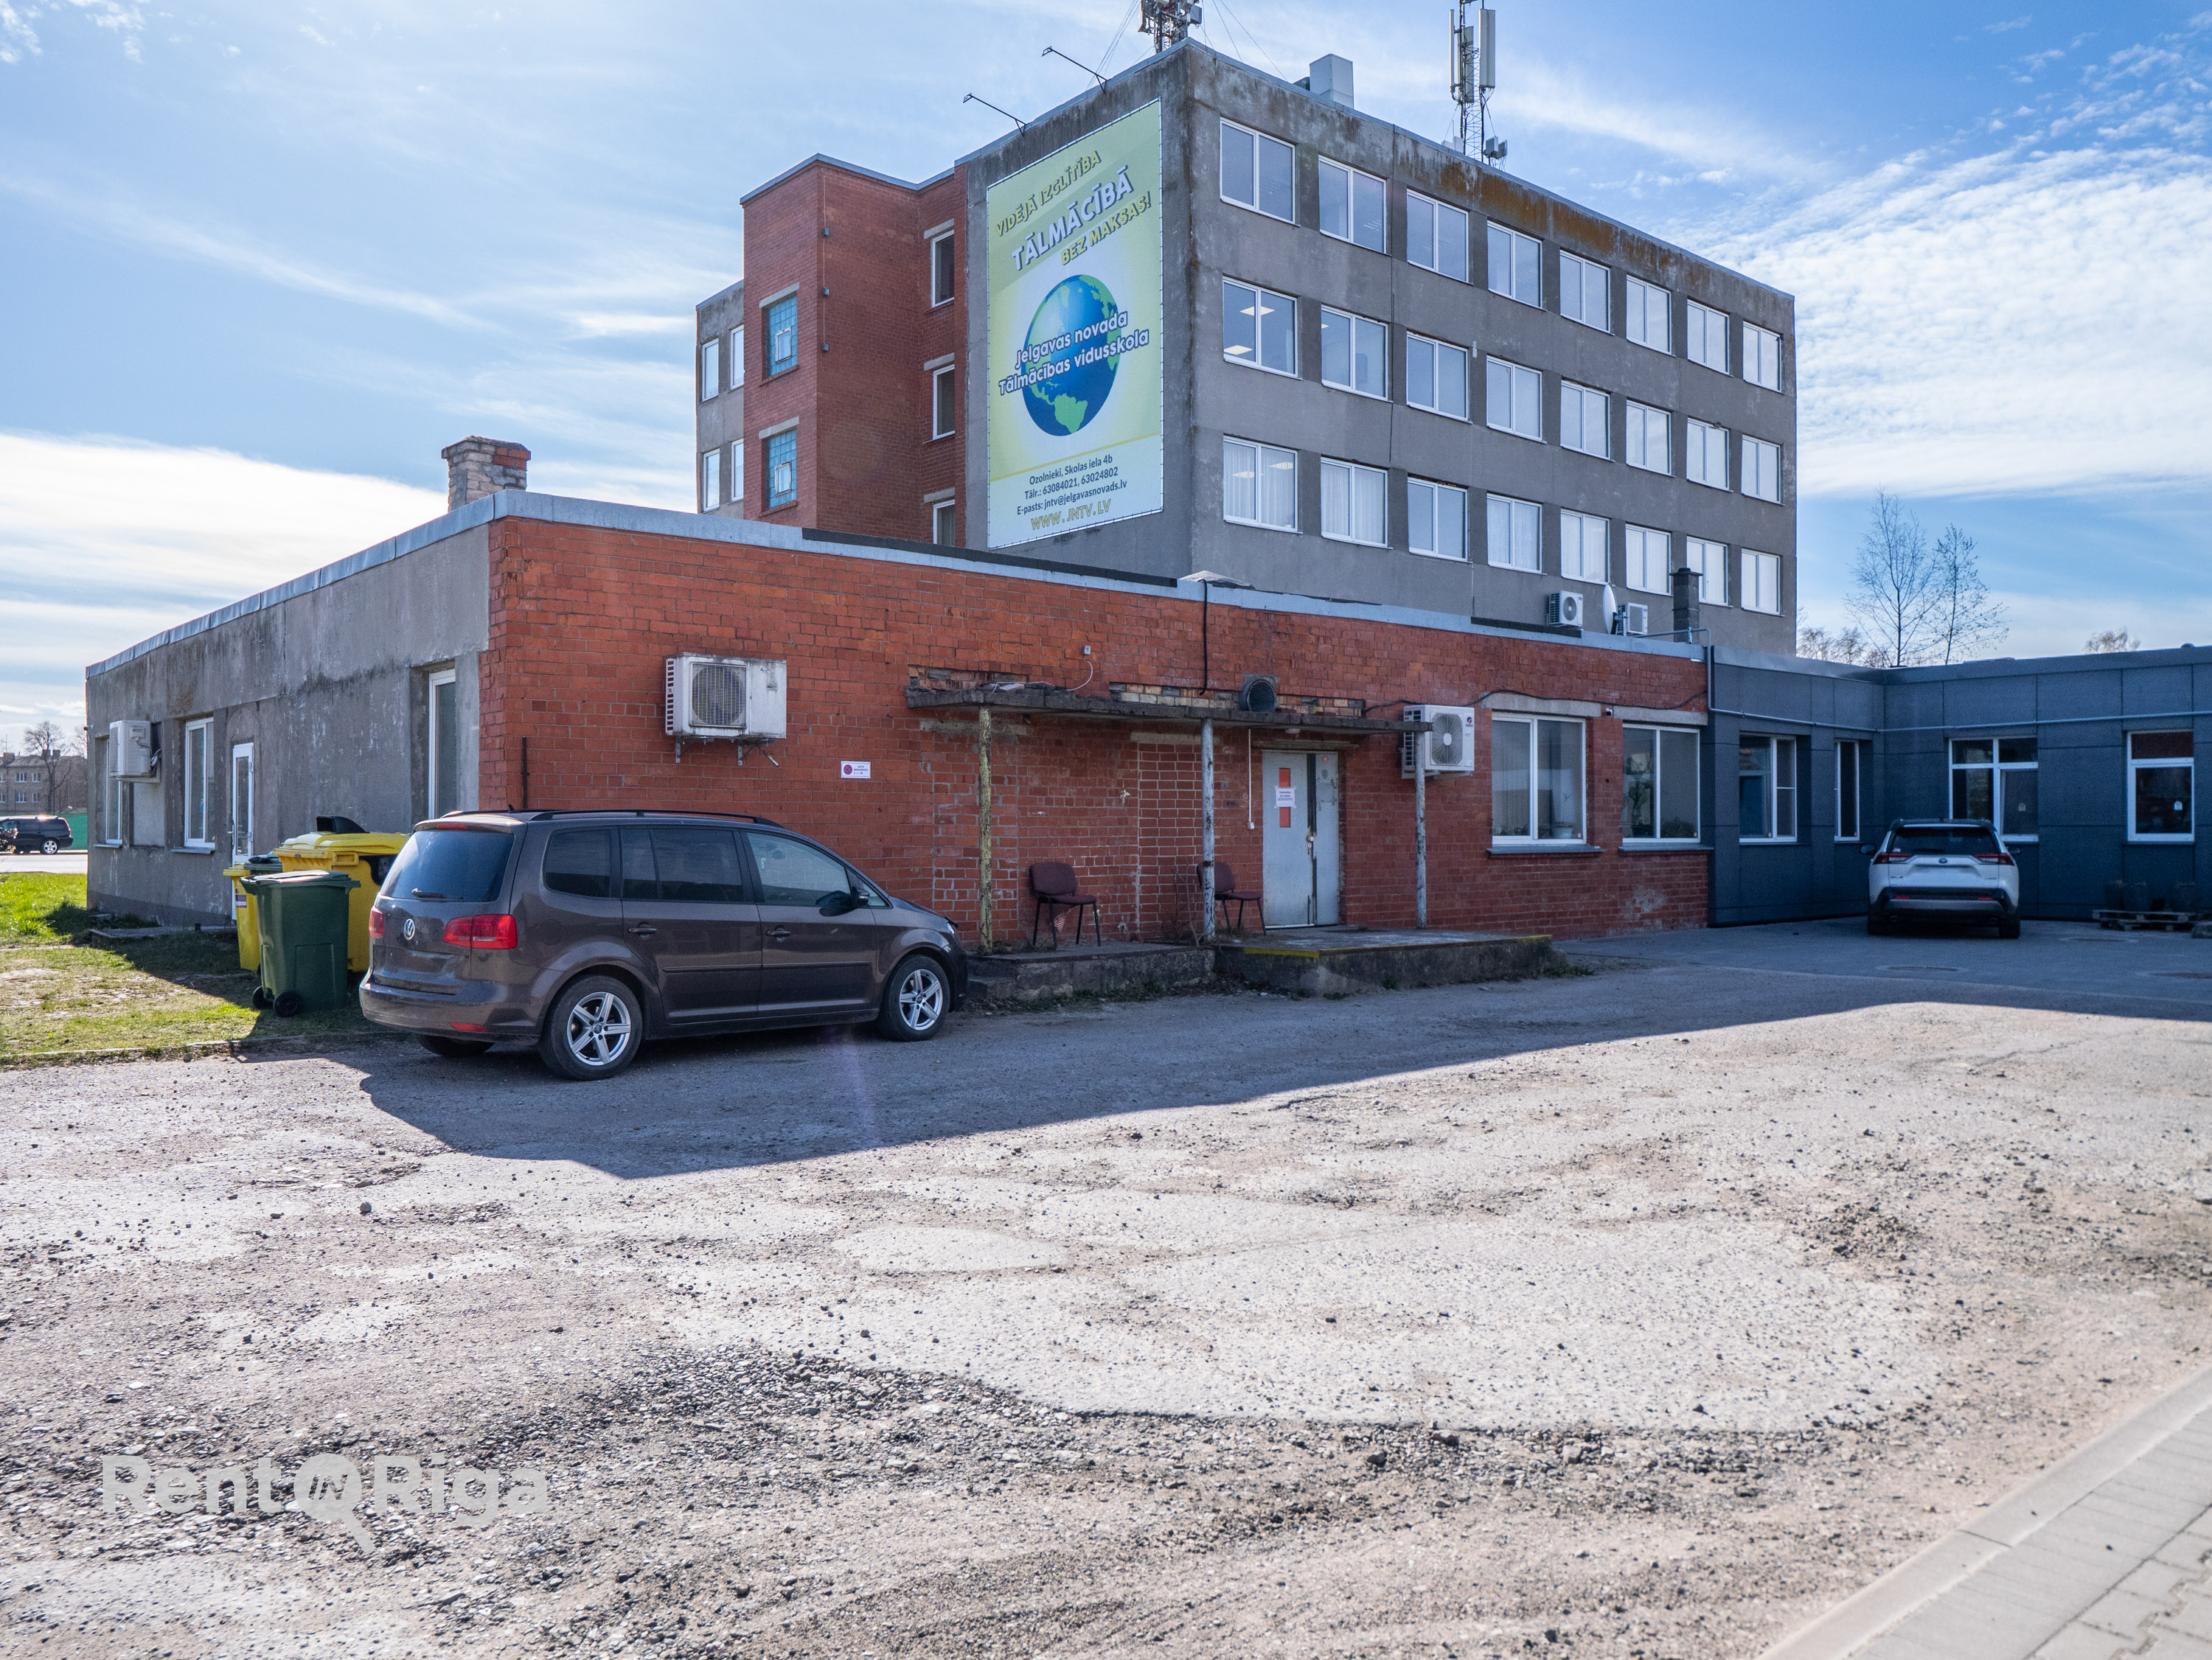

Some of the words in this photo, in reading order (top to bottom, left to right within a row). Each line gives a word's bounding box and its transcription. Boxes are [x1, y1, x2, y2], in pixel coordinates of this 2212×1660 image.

[995, 194, 1038, 237] VIDĒJĀ
[1039, 150, 1102, 206] IZGLĪTĪBA
[1011, 165, 1134, 271] TĀLMĀCĪBĀ
[1061, 236, 1088, 266] BEZ
[1089, 191, 1152, 247] MAKSAS!
[998, 358, 1071, 396] Tālmācības
[1074, 329, 1150, 369] vidusskola
[1015, 333, 1072, 369] Jelgavas
[1074, 310, 1128, 344] novada
[1017, 503, 1043, 516] E-pasts:
[1043, 479, 1127, 511] jntv@jelgavasnovads.lv
[1024, 489, 1042, 500] Tālr.:
[1043, 479, 1080, 495] 63084021,
[1081, 467, 1119, 485] 63024802
[1029, 467, 1064, 486] Ozolnieki,
[1065, 461, 1088, 475] Skolas
[1088, 458, 1102, 469] iela
[1103, 453, 1113, 465] 4b
